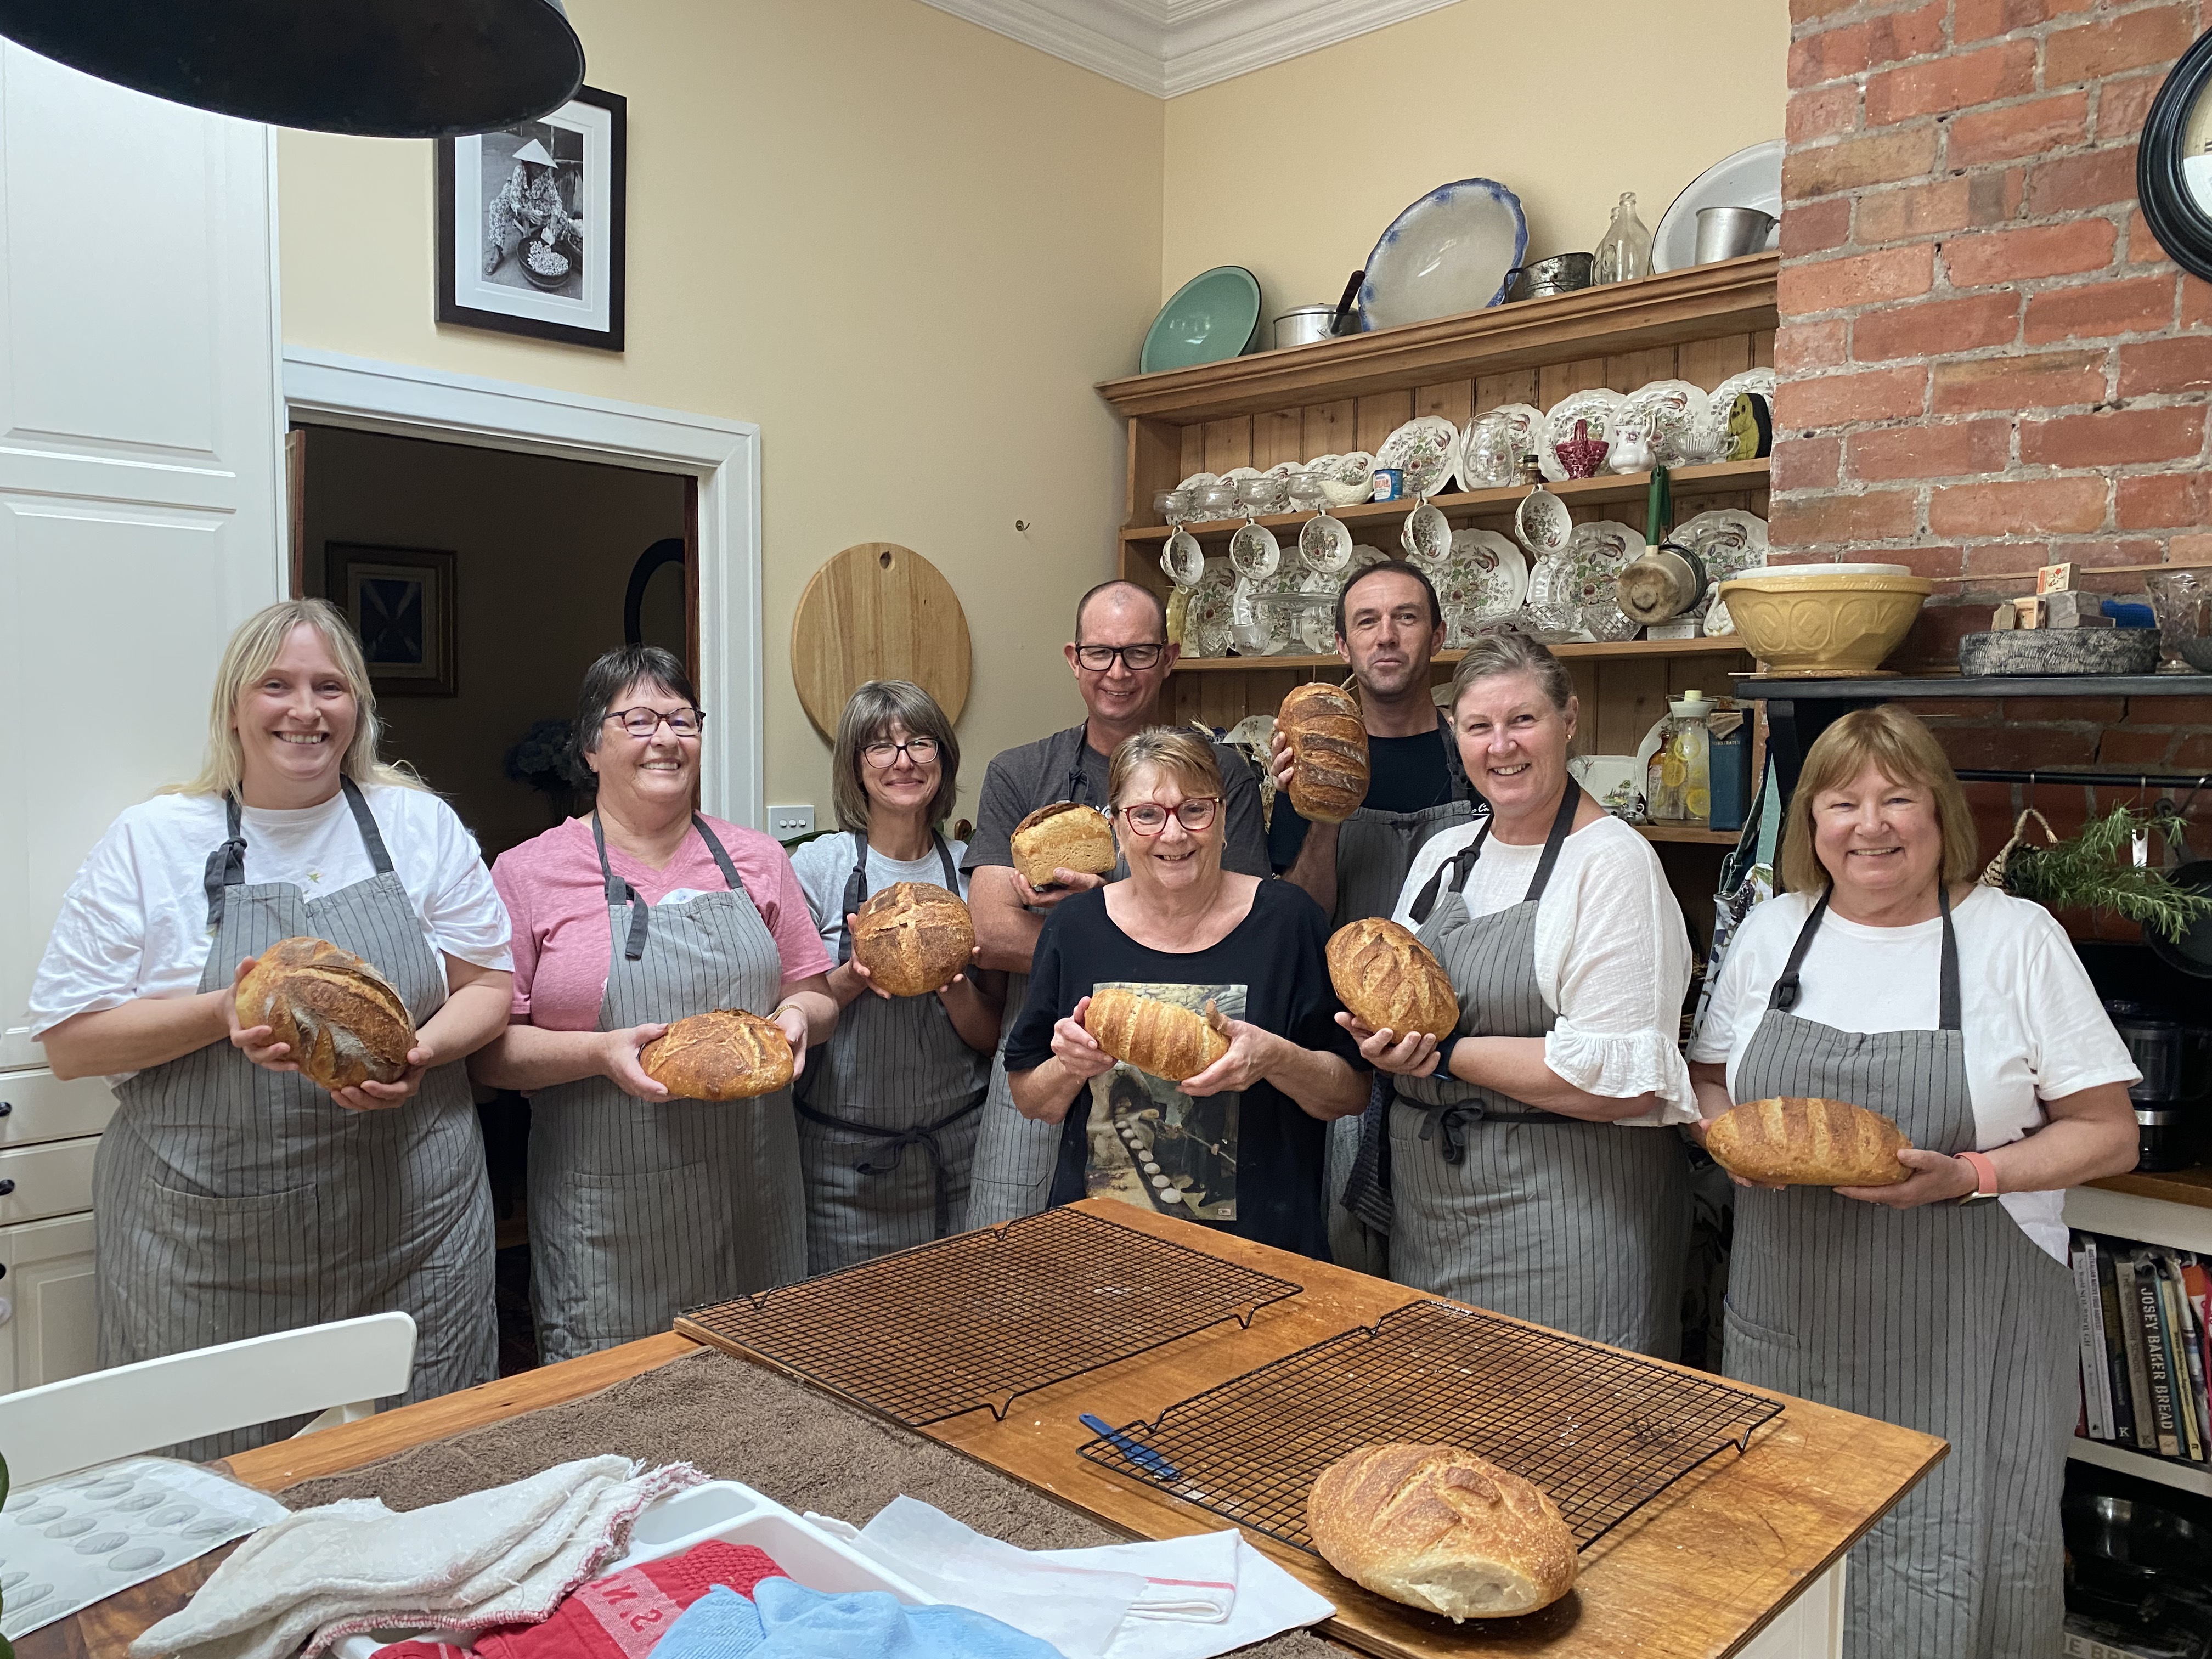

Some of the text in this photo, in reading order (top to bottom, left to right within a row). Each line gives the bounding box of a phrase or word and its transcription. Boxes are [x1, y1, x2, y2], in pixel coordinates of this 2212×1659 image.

[2088, 1249, 2096, 1278] AUSTRALIAN
[2124, 1291, 2137, 1340] SOURDOUGH
[2131, 1342, 2141, 1373] SCHOOL
[2141, 1288, 2173, 1429] JOSEY BAKER BREAD
[2118, 1427, 2129, 1437] K
